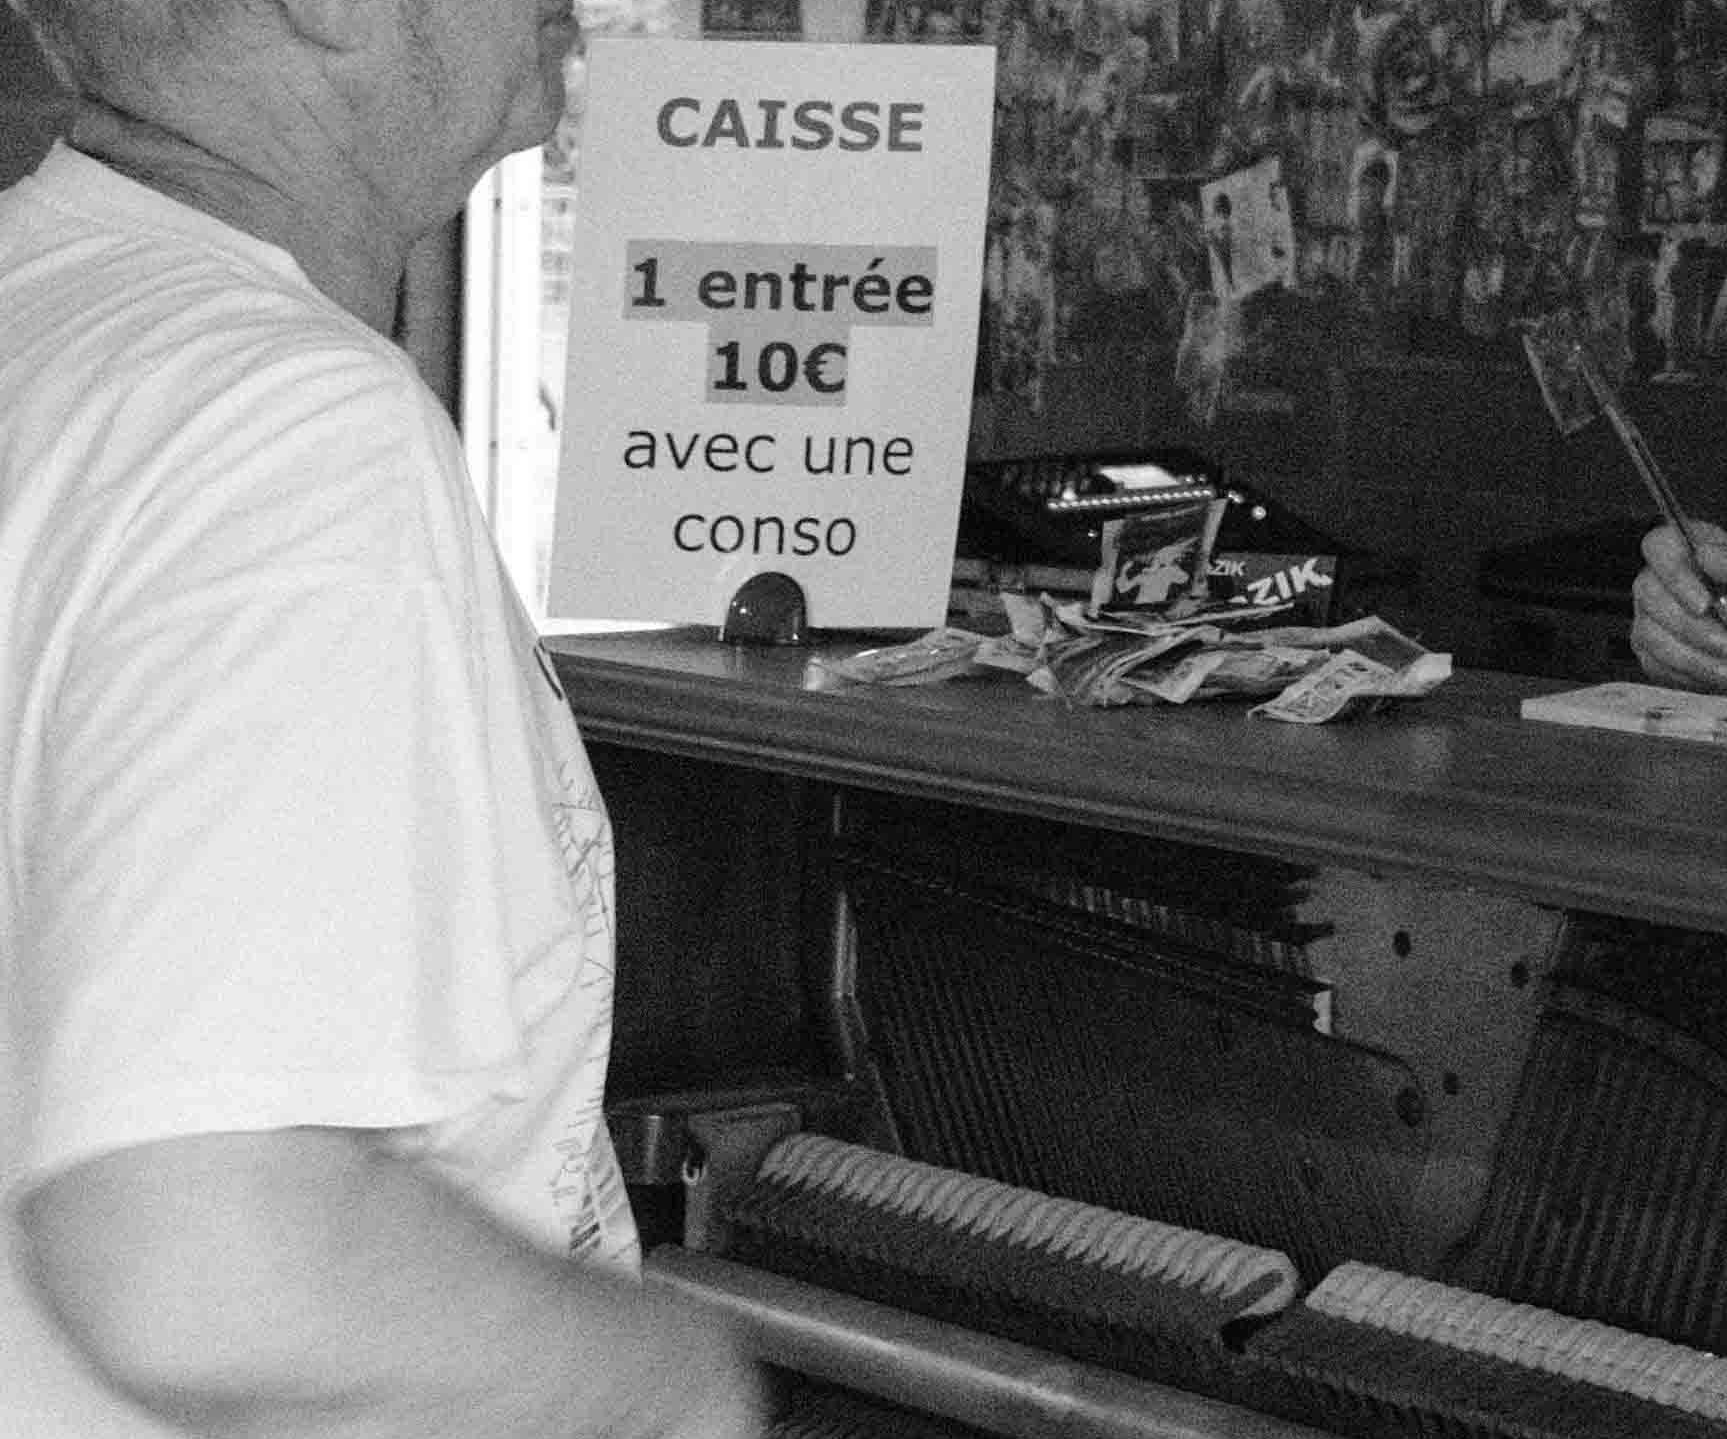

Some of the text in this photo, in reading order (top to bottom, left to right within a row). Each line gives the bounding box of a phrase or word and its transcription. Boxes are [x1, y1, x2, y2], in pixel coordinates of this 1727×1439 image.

[657, 96, 925, 152] CAISSE
[631, 257, 935, 315] 1 entrée
[713, 340, 848, 394] 10€
[623, 429, 914, 476] avec une
[673, 513, 857, 557] conso
